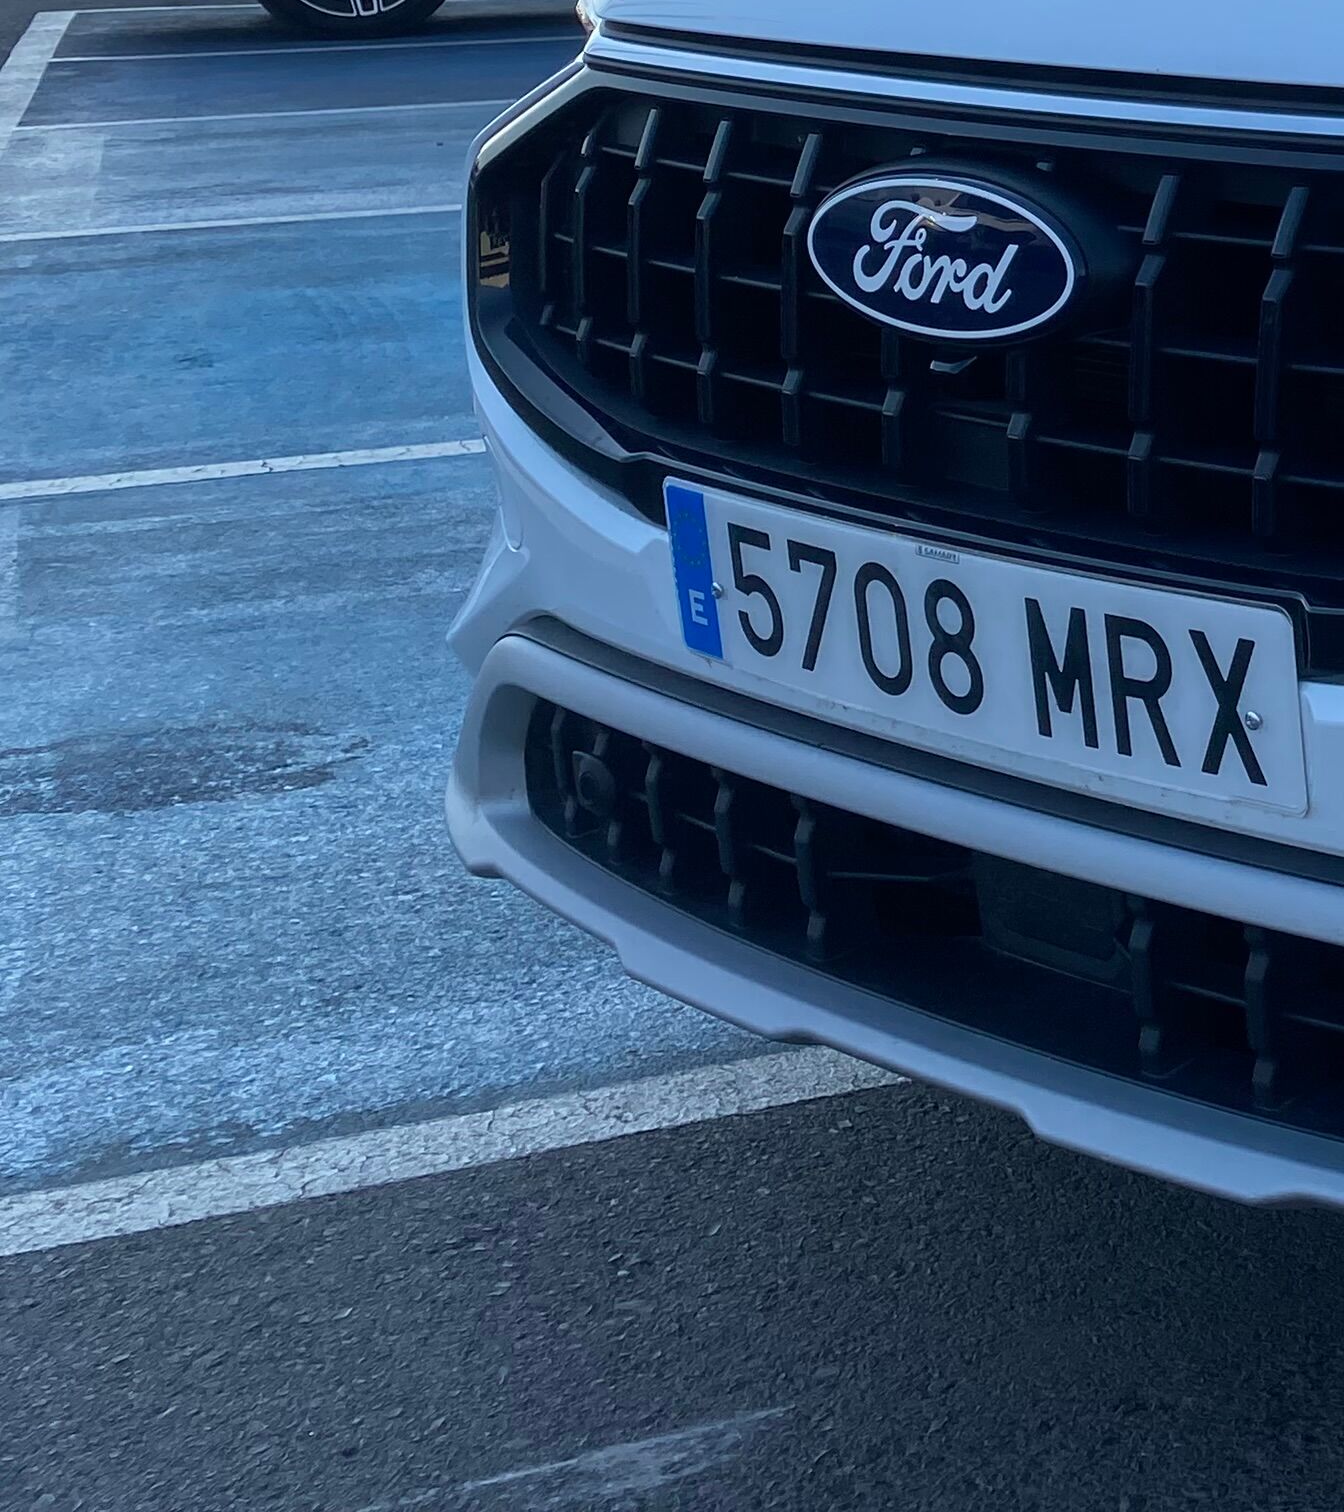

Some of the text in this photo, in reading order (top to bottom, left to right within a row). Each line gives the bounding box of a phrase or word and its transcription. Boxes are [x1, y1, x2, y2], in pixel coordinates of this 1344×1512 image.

[853, 199, 1018, 313] Ford
[690, 590, 709, 627] E
[727, 522, 1268, 788] 5708 MRX
